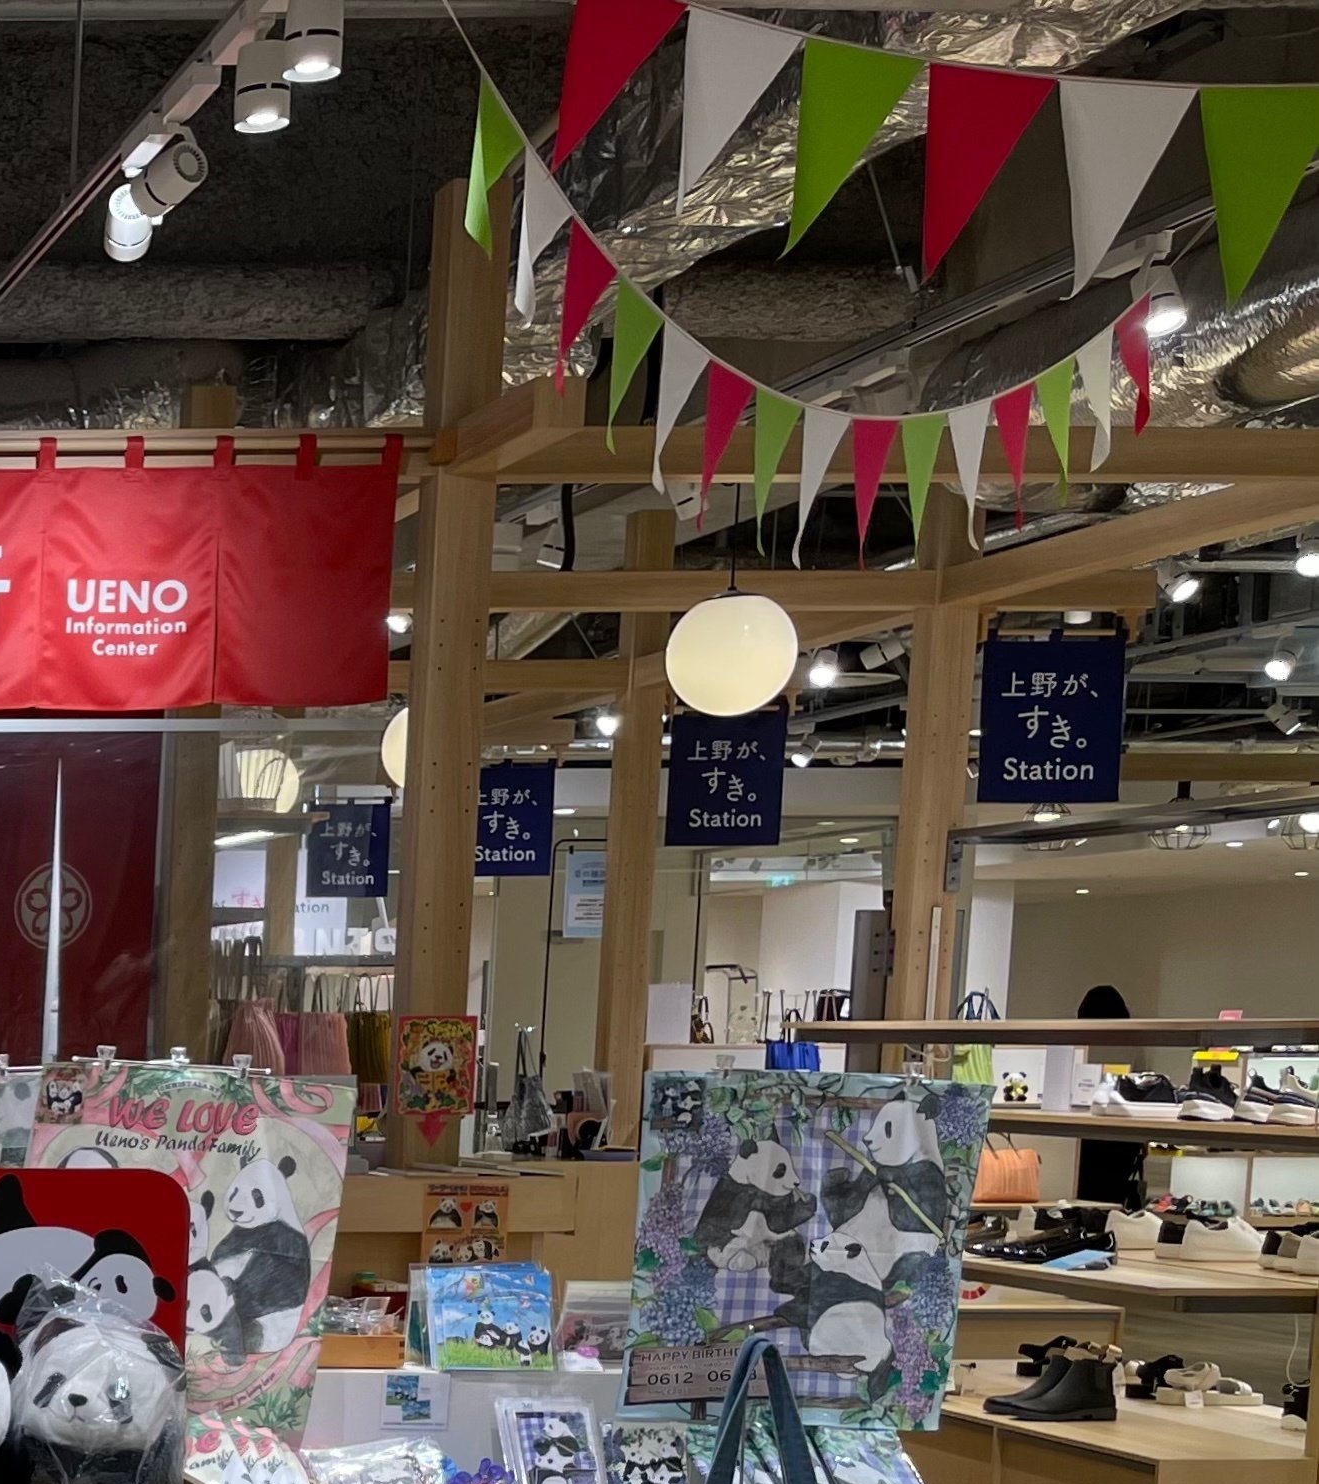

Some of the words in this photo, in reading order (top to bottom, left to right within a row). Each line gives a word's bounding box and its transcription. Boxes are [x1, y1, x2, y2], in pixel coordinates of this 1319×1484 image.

[67, 579, 188, 613] UENO
[65, 616, 187, 635] Information
[92, 639, 158, 657] Center
[1001, 671, 1099, 698] 上野が、
[1018, 705, 1088, 749] すき。
[687, 740, 766, 762] 上野が、
[1003, 757, 1095, 781] Station
[701, 767, 757, 802] すき。
[482, 811, 531, 841] すき。
[688, 808, 762, 828] Station
[475, 846, 537, 863] Station
[322, 870, 375, 886] Station
[109, 1096, 170, 1130] WE
[176, 1099, 261, 1136] LOVE
[154, 1135, 204, 1151] Panda
[208, 1137, 261, 1161] Family
[642, 1351, 690, 1362] HAPPY
[692, 1348, 740, 1360] BIRTH
[647, 1371, 693, 1386] 0612
